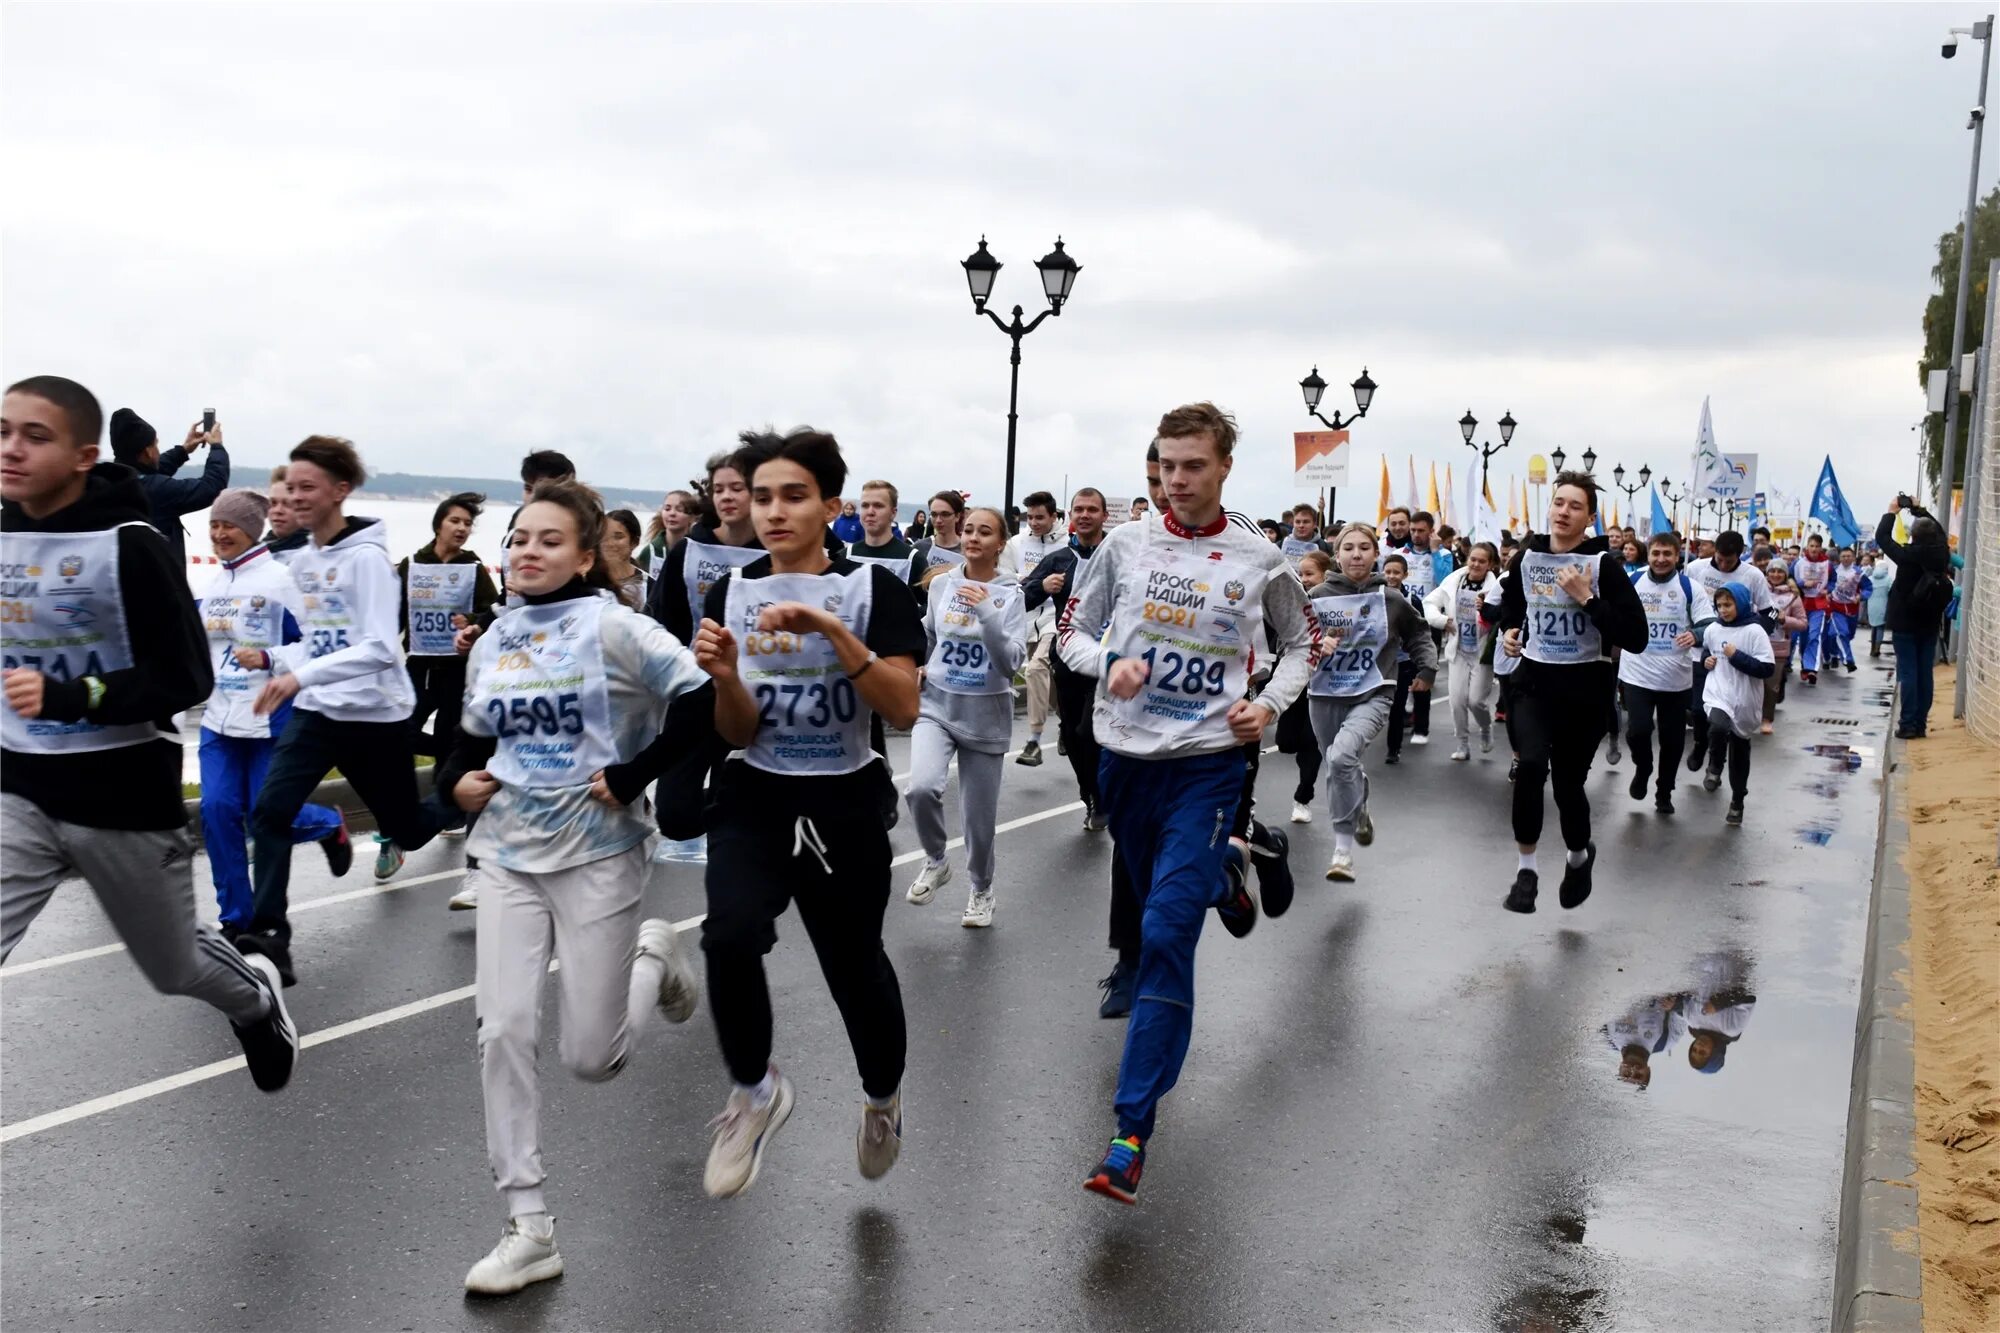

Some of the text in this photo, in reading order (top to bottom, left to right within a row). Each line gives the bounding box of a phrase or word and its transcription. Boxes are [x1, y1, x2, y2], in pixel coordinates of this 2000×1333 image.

[1167, 519, 1186, 536] 2012
[1148, 570, 1195, 593] КРОСС
[1530, 565, 1555, 575] КРОСС
[1145, 585, 1206, 611] НАЦИИ
[1142, 602, 1197, 630] 2021
[1321, 619, 1353, 627] НАЦИИ
[1534, 610, 1586, 637] 1210
[745, 633, 804, 656] 2021
[1141, 646, 1226, 697] 1289
[756, 678, 857, 728] 2730
[1142, 704, 1207, 722] РЕСПУБЛИКА
[1146, 692, 1208, 711] ЧУВАШСКАЯ
[487, 692, 584, 739] 2595
[773, 731, 843, 745] ЧУВАШСКАЯ
[774, 747, 848, 760] РЕСПУБЛИКА
